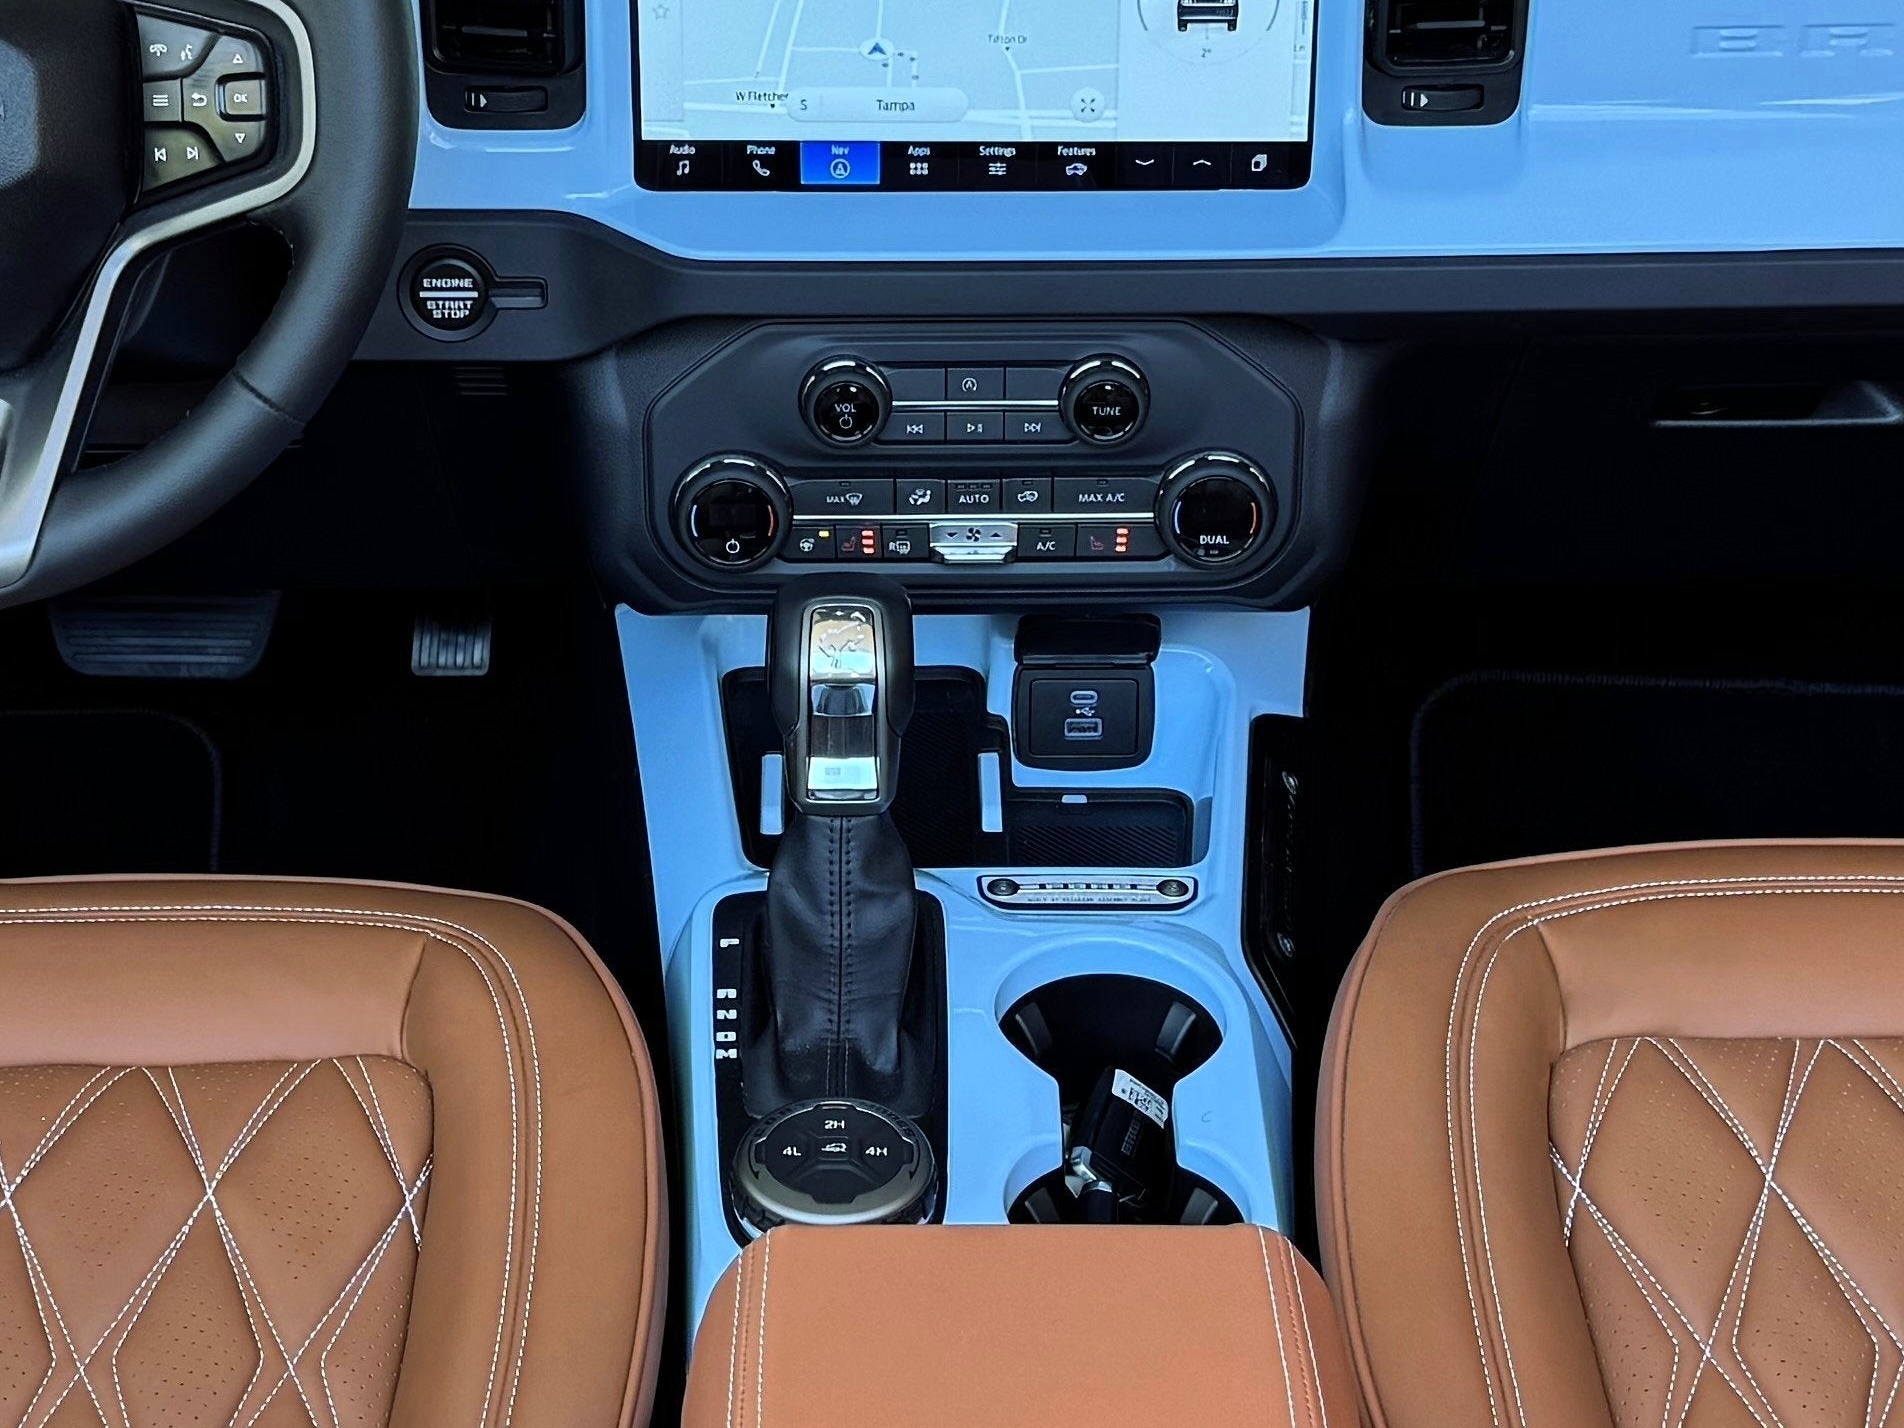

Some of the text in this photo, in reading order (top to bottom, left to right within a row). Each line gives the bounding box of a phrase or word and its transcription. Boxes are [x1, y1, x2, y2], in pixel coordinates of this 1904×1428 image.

[234, 94, 248, 104] OK
[800, 99, 807, 112] S
[877, 99, 915, 113] Tampa
[667, 144, 696, 156] Audio
[747, 144, 776, 156] Phone
[831, 145, 849, 155] Nav
[907, 145, 931, 157] Apps
[979, 145, 1016, 158] Settings
[1057, 145, 1096, 157] Features
[422, 278, 473, 288] ENGINE
[427, 300, 473, 310] START
[432, 310, 469, 319] STOP
[834, 403, 856, 413] VOL
[1092, 406, 1121, 416] TUNE
[959, 494, 989, 504] AUTO
[1079, 493, 1125, 503] MAX A/C
[1200, 535, 1229, 545] DUAL
[1036, 541, 1056, 551] A/C
[825, 1119, 845, 1130] 2H
[783, 1146, 801, 1156] 4L
[865, 1146, 888, 1157] 4H
